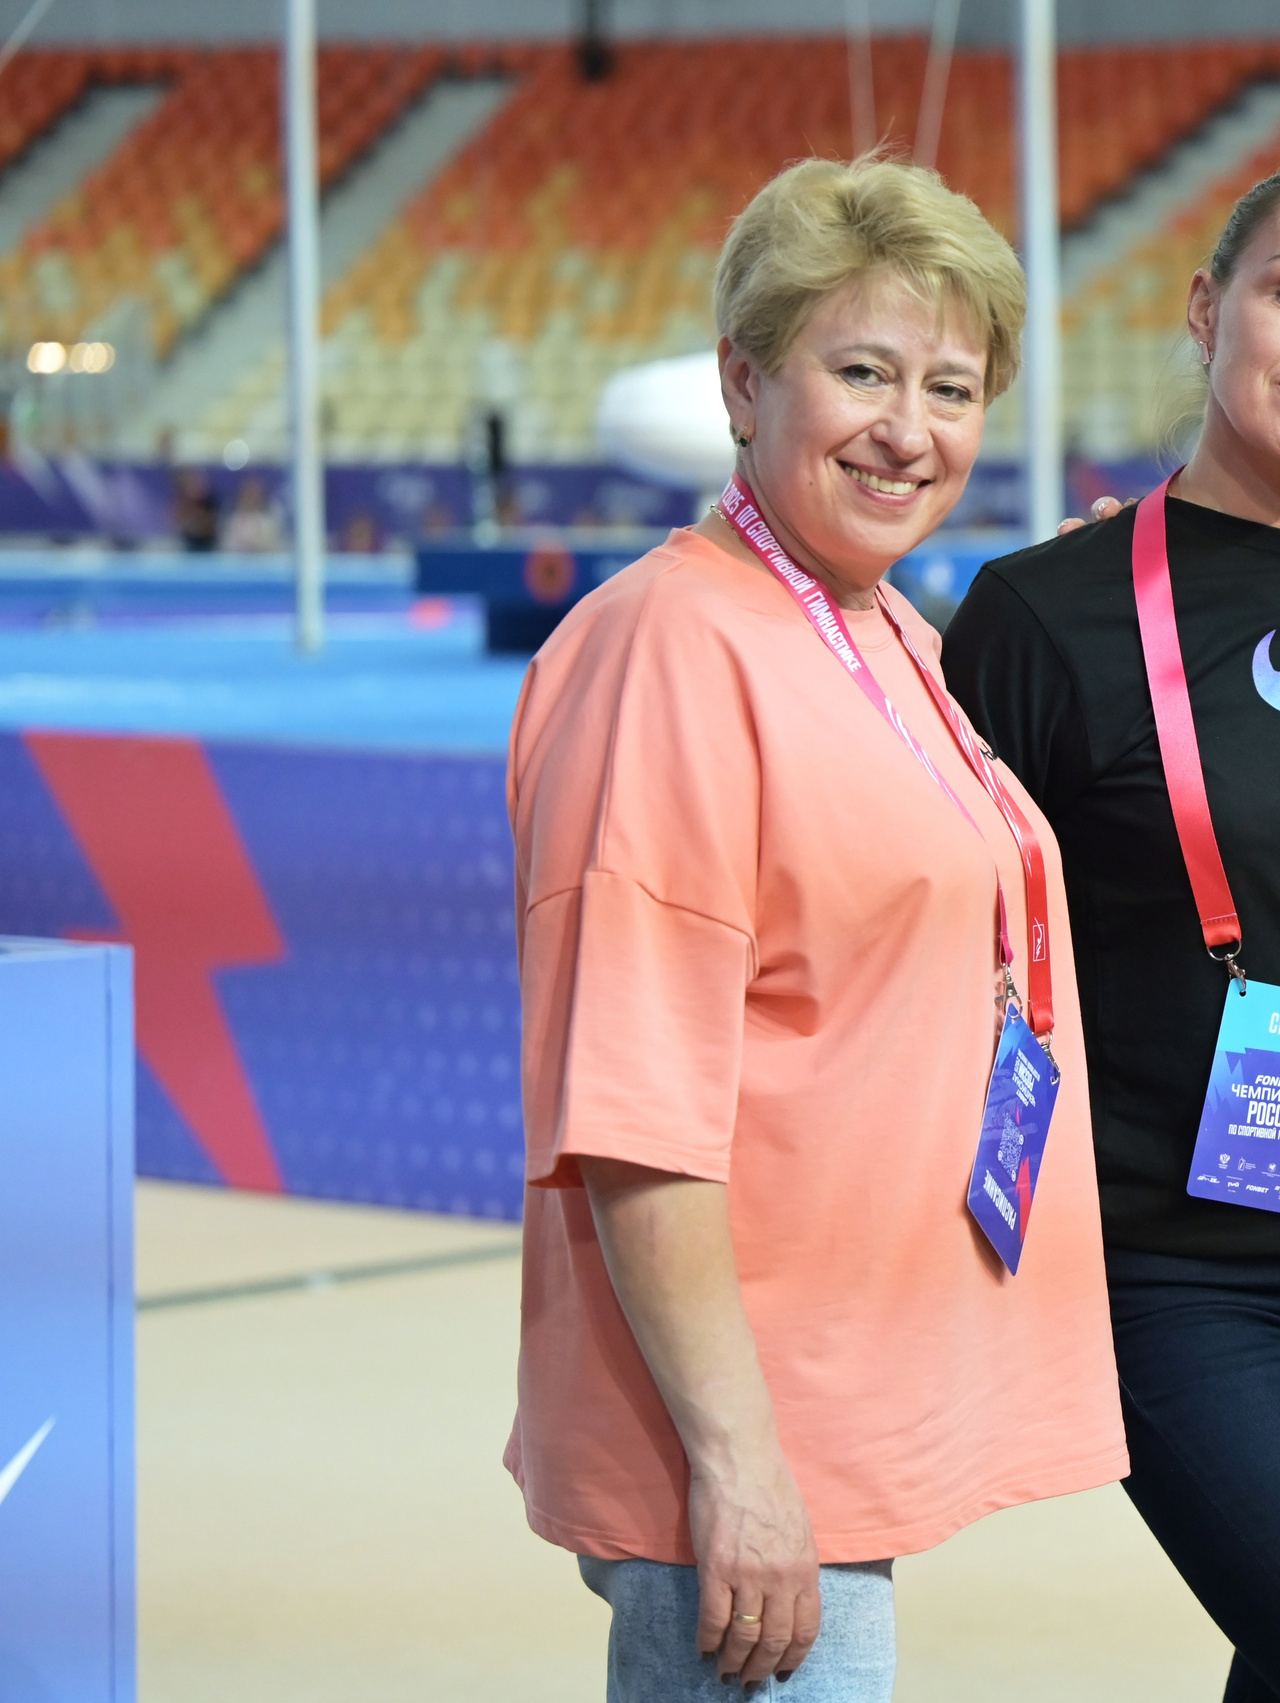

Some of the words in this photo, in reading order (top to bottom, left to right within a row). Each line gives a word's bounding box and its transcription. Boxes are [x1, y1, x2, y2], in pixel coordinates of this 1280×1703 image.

[722, 483, 746, 516] 2025
[734, 504, 760, 529] ПО
[745, 518, 815, 595] СПОРТИВНОЙ
[802, 585, 863, 673] ГИМНАСТИКЕ
[1228, 1123, 1238, 1135] ПО
[1237, 1124, 1278, 1140] СПОРТИВНОЙ
[983, 1168, 1018, 1231] РАСПИСАНИЕ
[1245, 1184, 1270, 1194] FONBET
